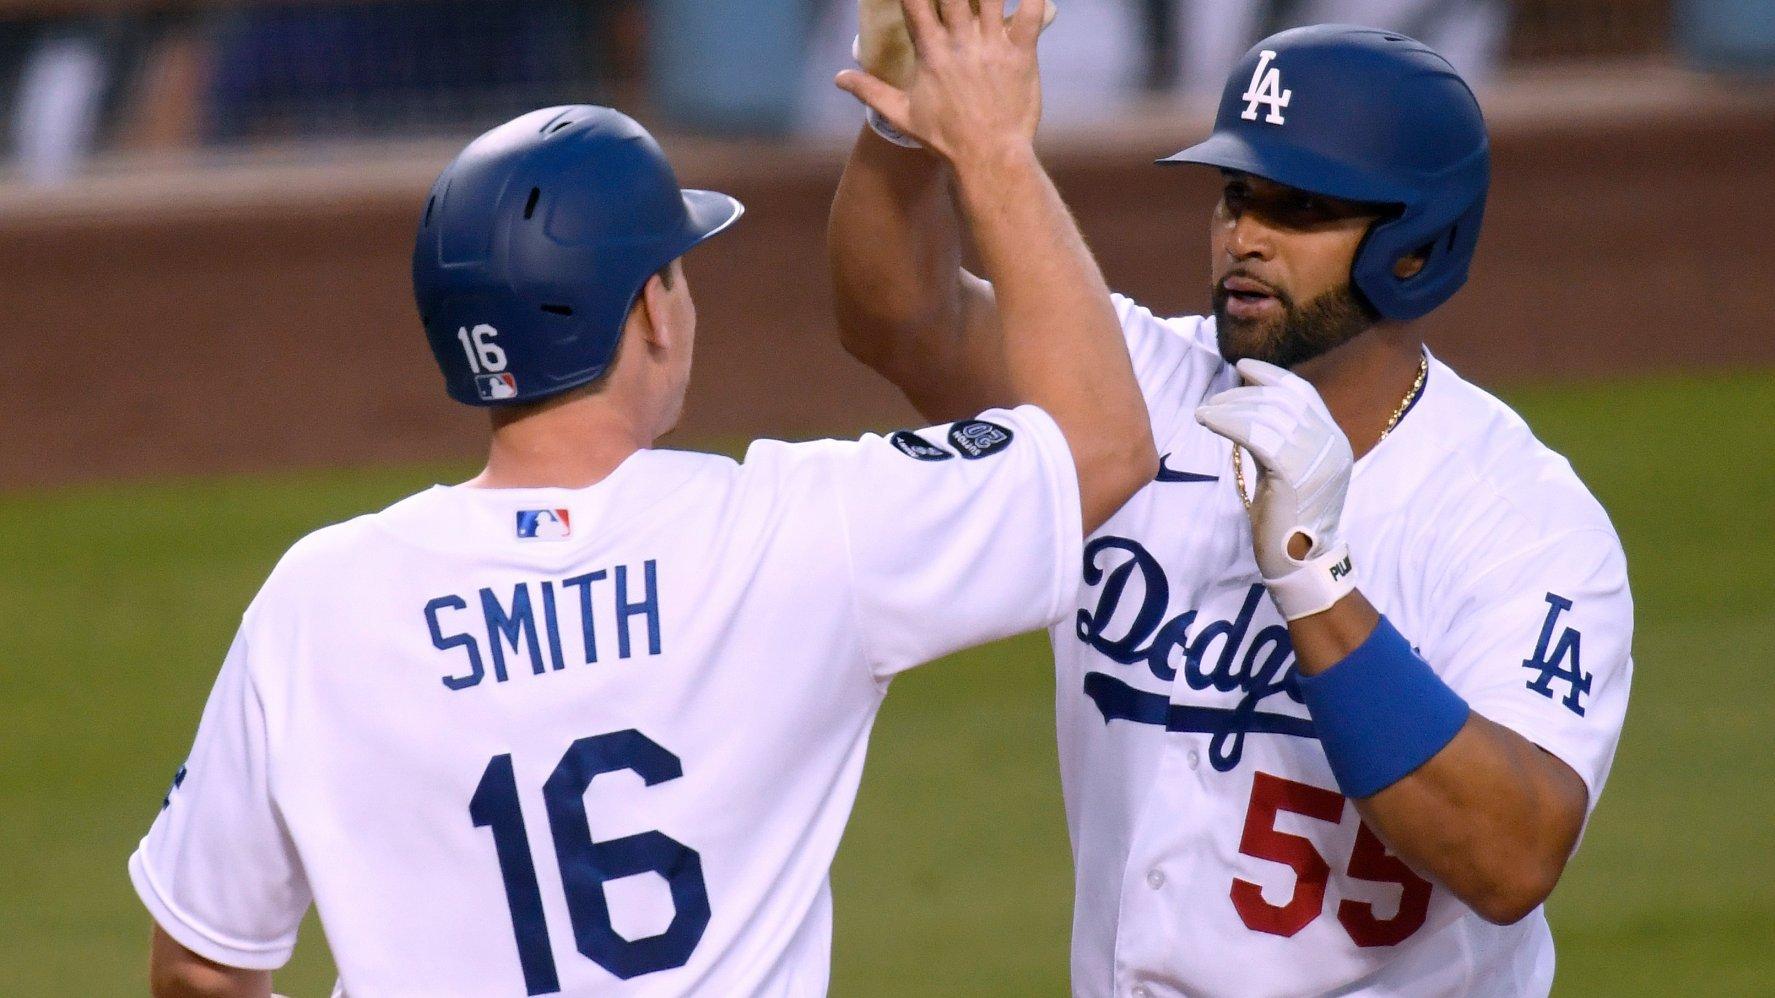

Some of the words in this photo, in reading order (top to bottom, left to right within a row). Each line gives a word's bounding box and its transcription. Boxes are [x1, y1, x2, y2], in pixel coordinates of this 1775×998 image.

[1241, 50, 1292, 125] LA
[457, 324, 507, 373] 16
[424, 559, 662, 691] SMITH
[1076, 535, 1307, 772] Dodg
[1522, 592, 1593, 718] LA
[469, 728, 712, 996] 16
[1230, 770, 1433, 948] 55
